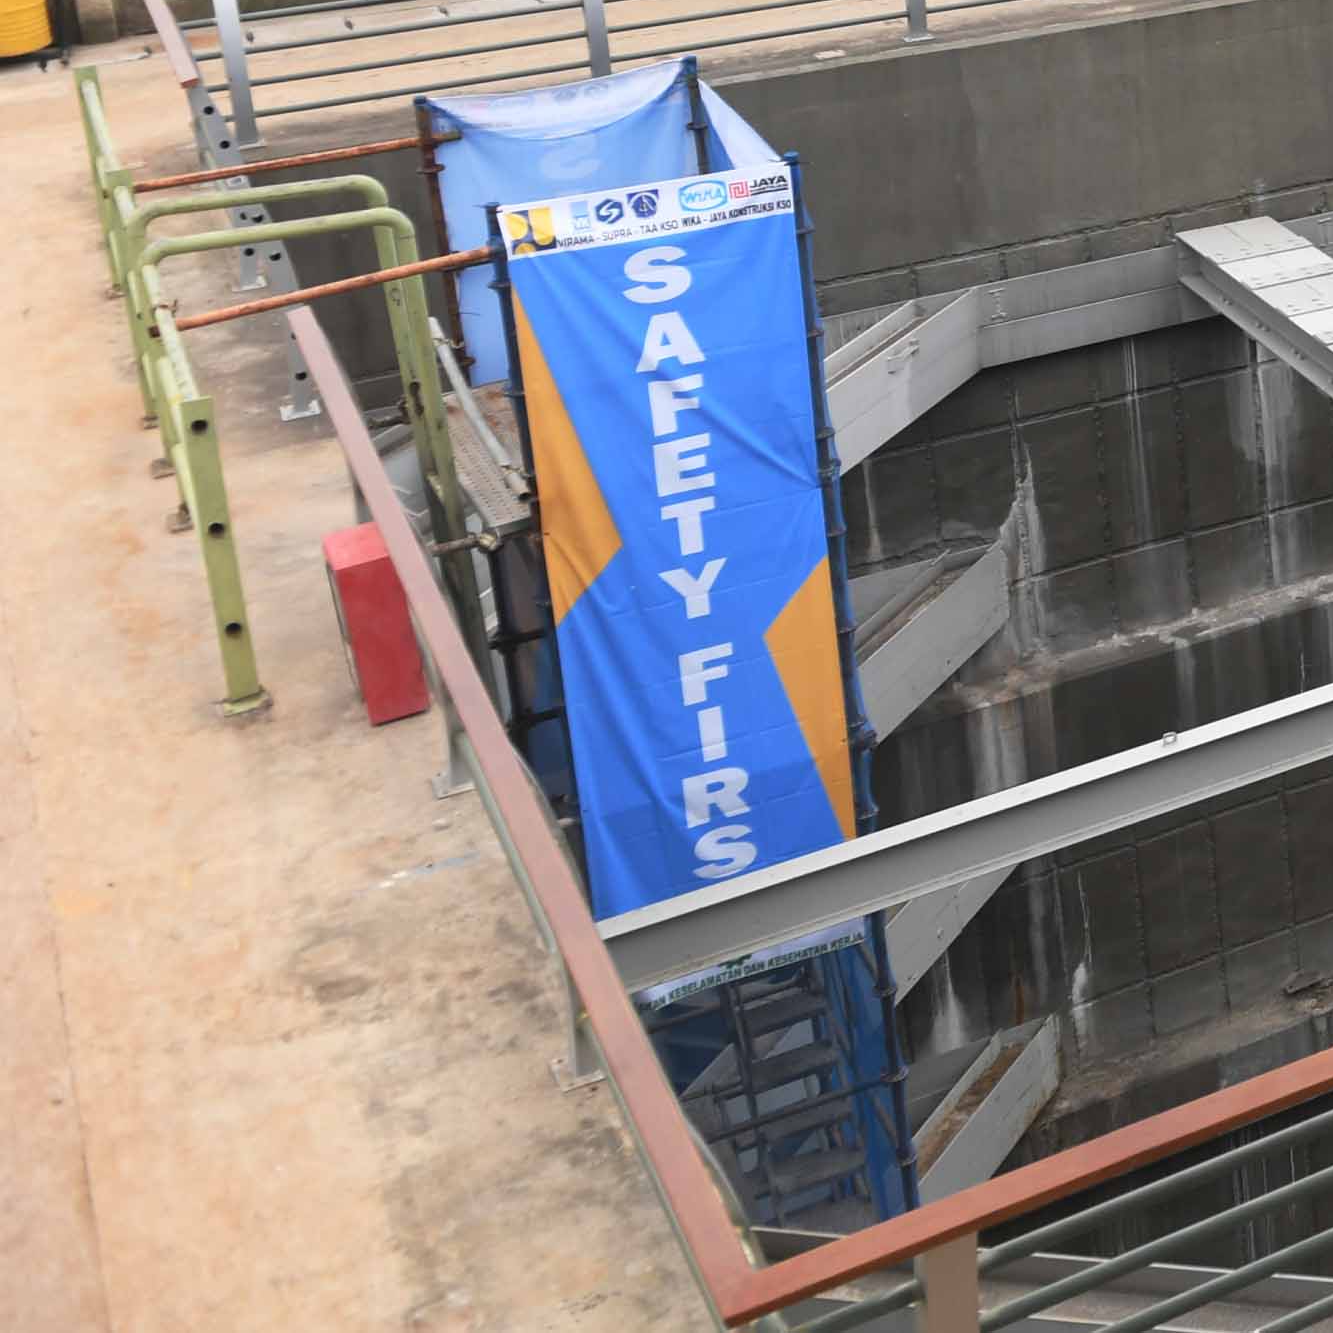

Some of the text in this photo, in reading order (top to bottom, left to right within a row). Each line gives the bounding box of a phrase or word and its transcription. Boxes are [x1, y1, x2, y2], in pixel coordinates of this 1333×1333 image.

[750, 175, 788, 188] JAYA
[640, 224, 658, 235] TAA
[682, 216, 702, 227] WIKA
[709, 213, 727, 224] JAYA
[728, 203, 775, 220] KONSTRUKSI
[776, 199, 792, 210] KSO
[622, 243, 728, 619] SAFETY
[669, 967, 742, 1002] KESELAMATAN
[743, 960, 766, 975] DAN
[767, 943, 828, 968] KESEHATAN
